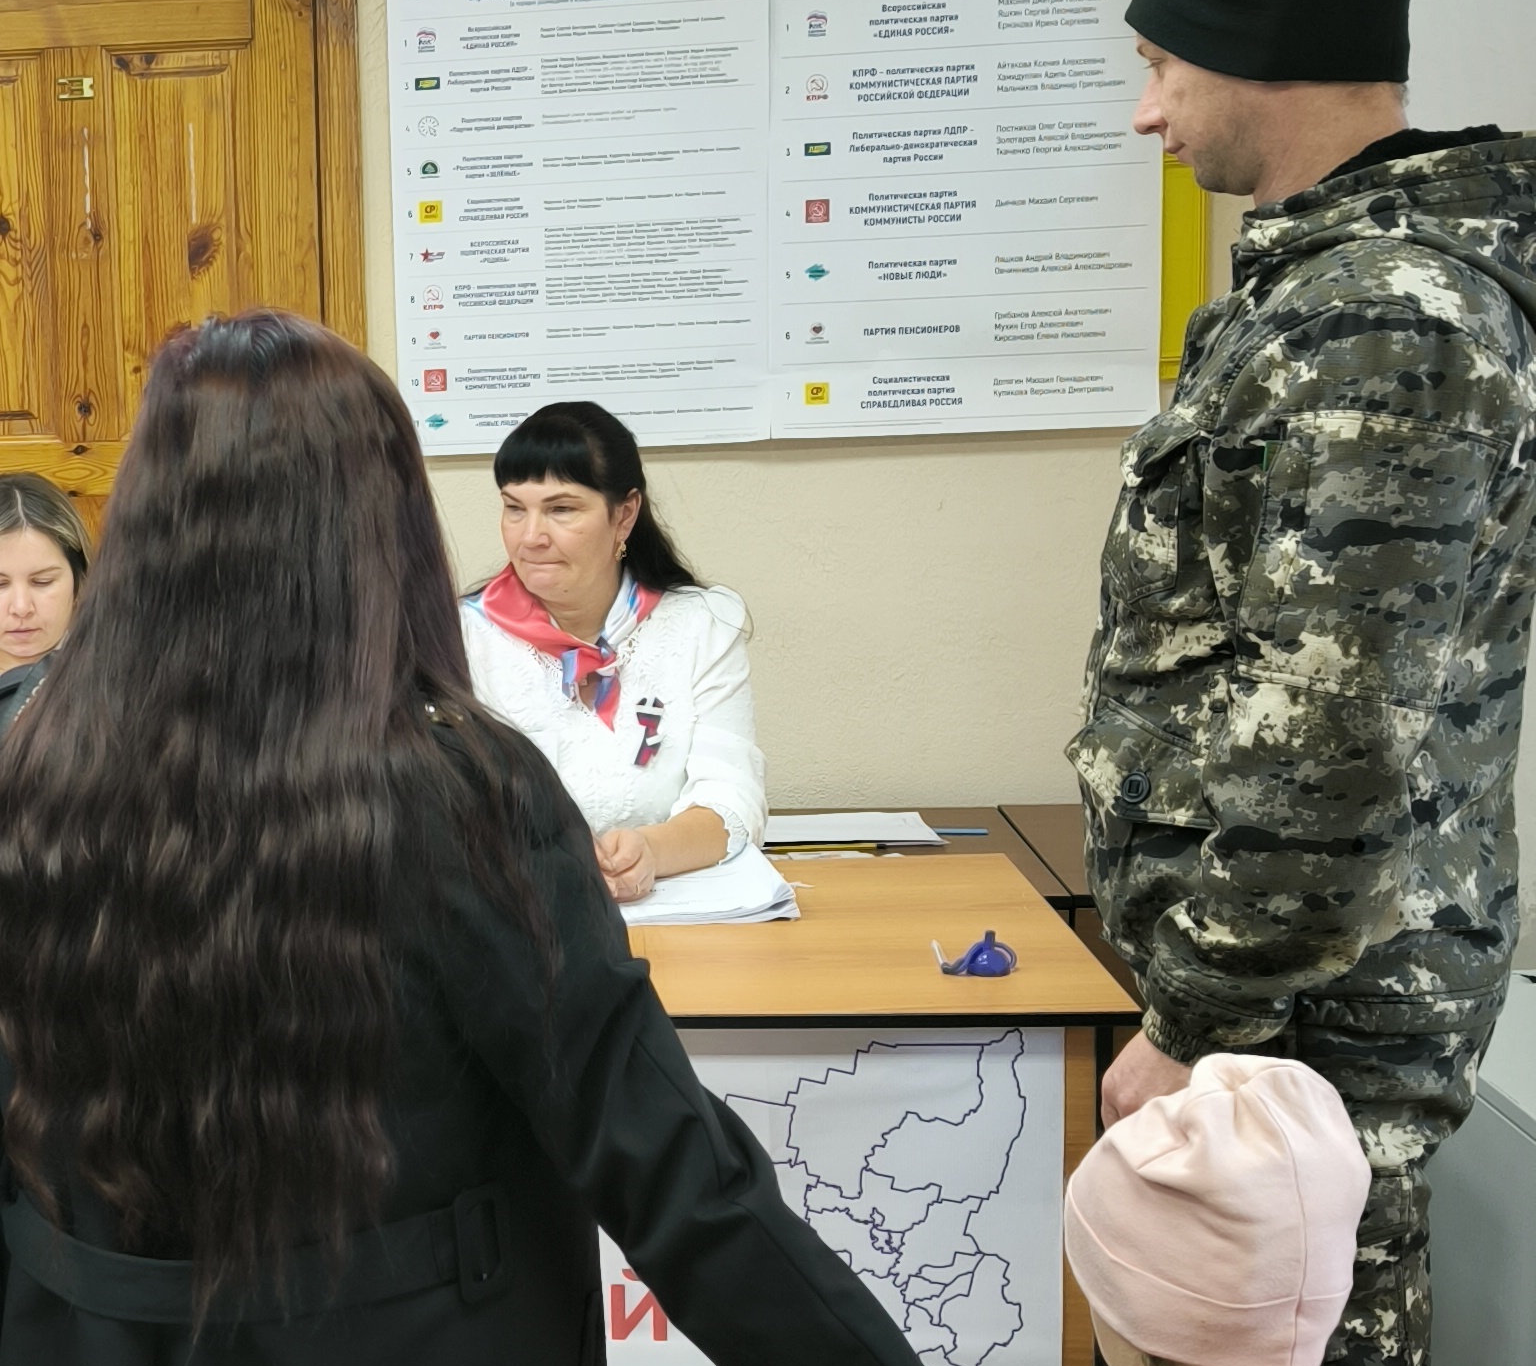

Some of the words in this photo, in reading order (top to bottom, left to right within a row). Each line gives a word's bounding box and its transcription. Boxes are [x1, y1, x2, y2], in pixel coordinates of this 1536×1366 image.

[881, 1, 946, 13] Всероссийская
[869, 16, 928, 26] политическая
[929, 14, 959, 23] партия
[873, 27, 913, 39] «ЕДИНАЯ
[914, 25, 954, 36] РОССИЯ»
[852, 67, 878, 77] КПРФ
[885, 65, 944, 75] политическая
[945, 63, 975, 73] партия
[849, 76, 942, 90] КОММУНИСТИЧЕСКАЯ
[944, 74, 978, 85] ПАРТИЯ
[785, 85, 790, 94] 2
[857, 89, 914, 102] РОССИЙСКОЙ
[916, 88, 969, 99] ФЕДЕРАЦИИ
[852, 130, 912, 140] Политическая
[913, 128, 942, 138] партия
[943, 125, 968, 136] ЛДПР
[849, 139, 978, 153] Либерально-демократическая
[785, 147, 791, 157] 3
[882, 155, 911, 164] партия
[913, 153, 943, 162] России
[868, 192, 927, 201] Политическая
[929, 190, 958, 199] партия
[849, 201, 941, 215] КОММУНИСТИЧЕСКАЯ
[943, 199, 976, 210] ПАРТИЯ
[408, 210, 413, 218] 6
[863, 215, 925, 226] КОММУНИСТЫ
[927, 213, 962, 223] РОССИИ
[409, 252, 414, 261] 7
[868, 260, 927, 269] Политическая
[928, 258, 957, 267] партия
[785, 270, 791, 279] 5
[877, 271, 913, 281] «НОВЫЕ
[914, 270, 947, 280] ЛЮДИ»
[410, 295, 415, 304] 8
[863, 327, 896, 336] ПАРТИЯ
[898, 324, 960, 335] ПЕНСИОНЕРОВ
[1020, 321, 1037, 330] Егор
[411, 337, 416, 345] 9
[785, 331, 790, 340] 6
[411, 378, 419, 387] 10
[872, 375, 950, 385] Социалистическая
[867, 388, 925, 396] политическая
[926, 386, 955, 395] партия
[860, 398, 927, 409] СПРАВЕДЛИВАЯ
[929, 397, 963, 406] РОССИЯ
